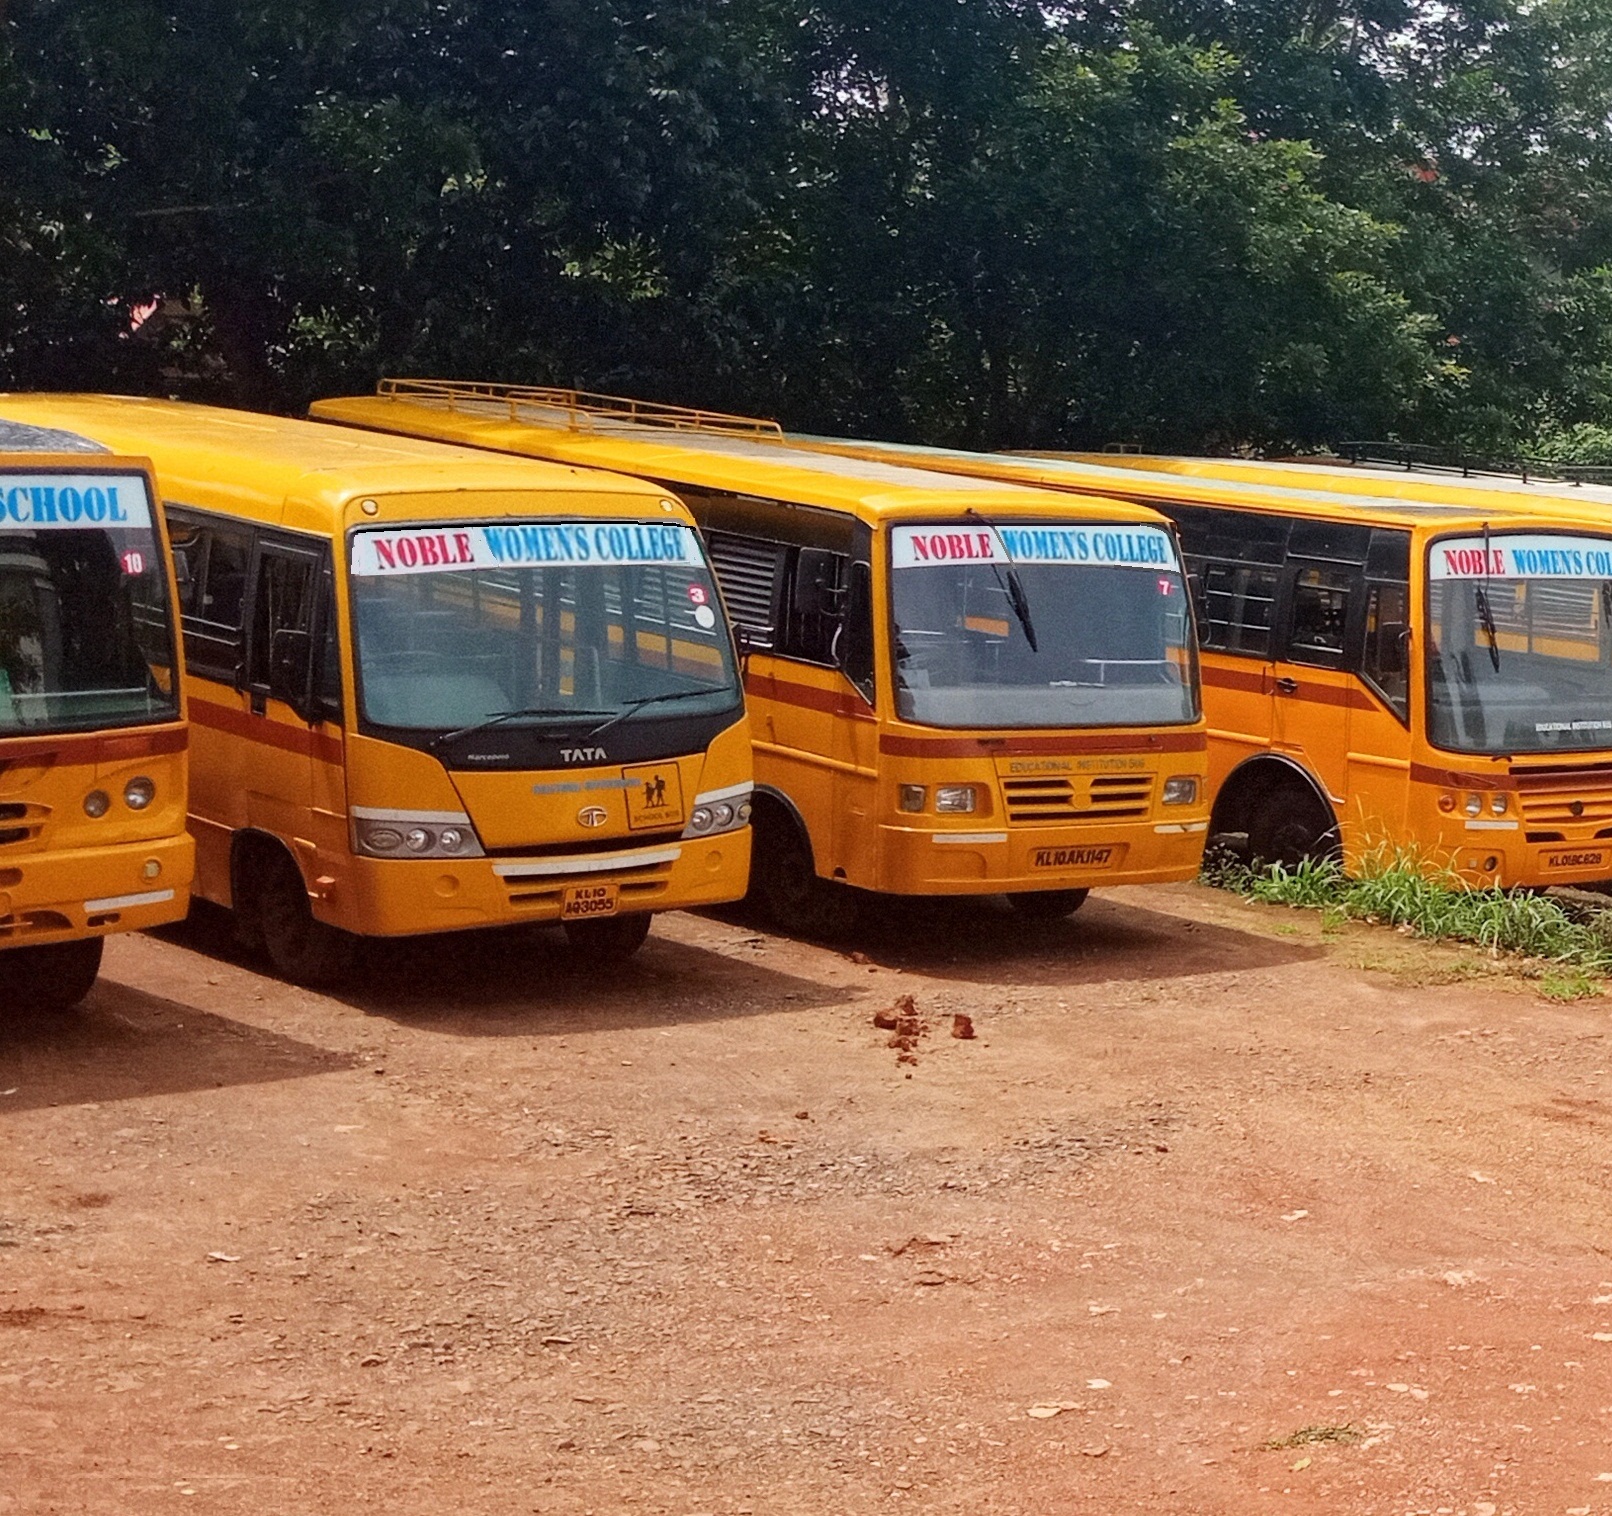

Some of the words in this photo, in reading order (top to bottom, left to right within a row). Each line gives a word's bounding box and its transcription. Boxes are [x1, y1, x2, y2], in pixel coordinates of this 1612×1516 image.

[371, 532, 475, 570] NOBLE
[594, 525, 687, 561] COLLEGE
[911, 533, 994, 561] NOBLE
[1001, 529, 1090, 562] WOMEN'S
[1092, 532, 1168, 564] COLLEGE
[124, 553, 143, 573] 10
[1443, 549, 1505, 576] NOBLE
[1511, 548, 1583, 575] WOMEN'S
[690, 587, 704, 602] 3
[1159, 580, 1169, 596] 7
[560, 748, 607, 762] TATA
[575, 887, 607, 900] KL10
